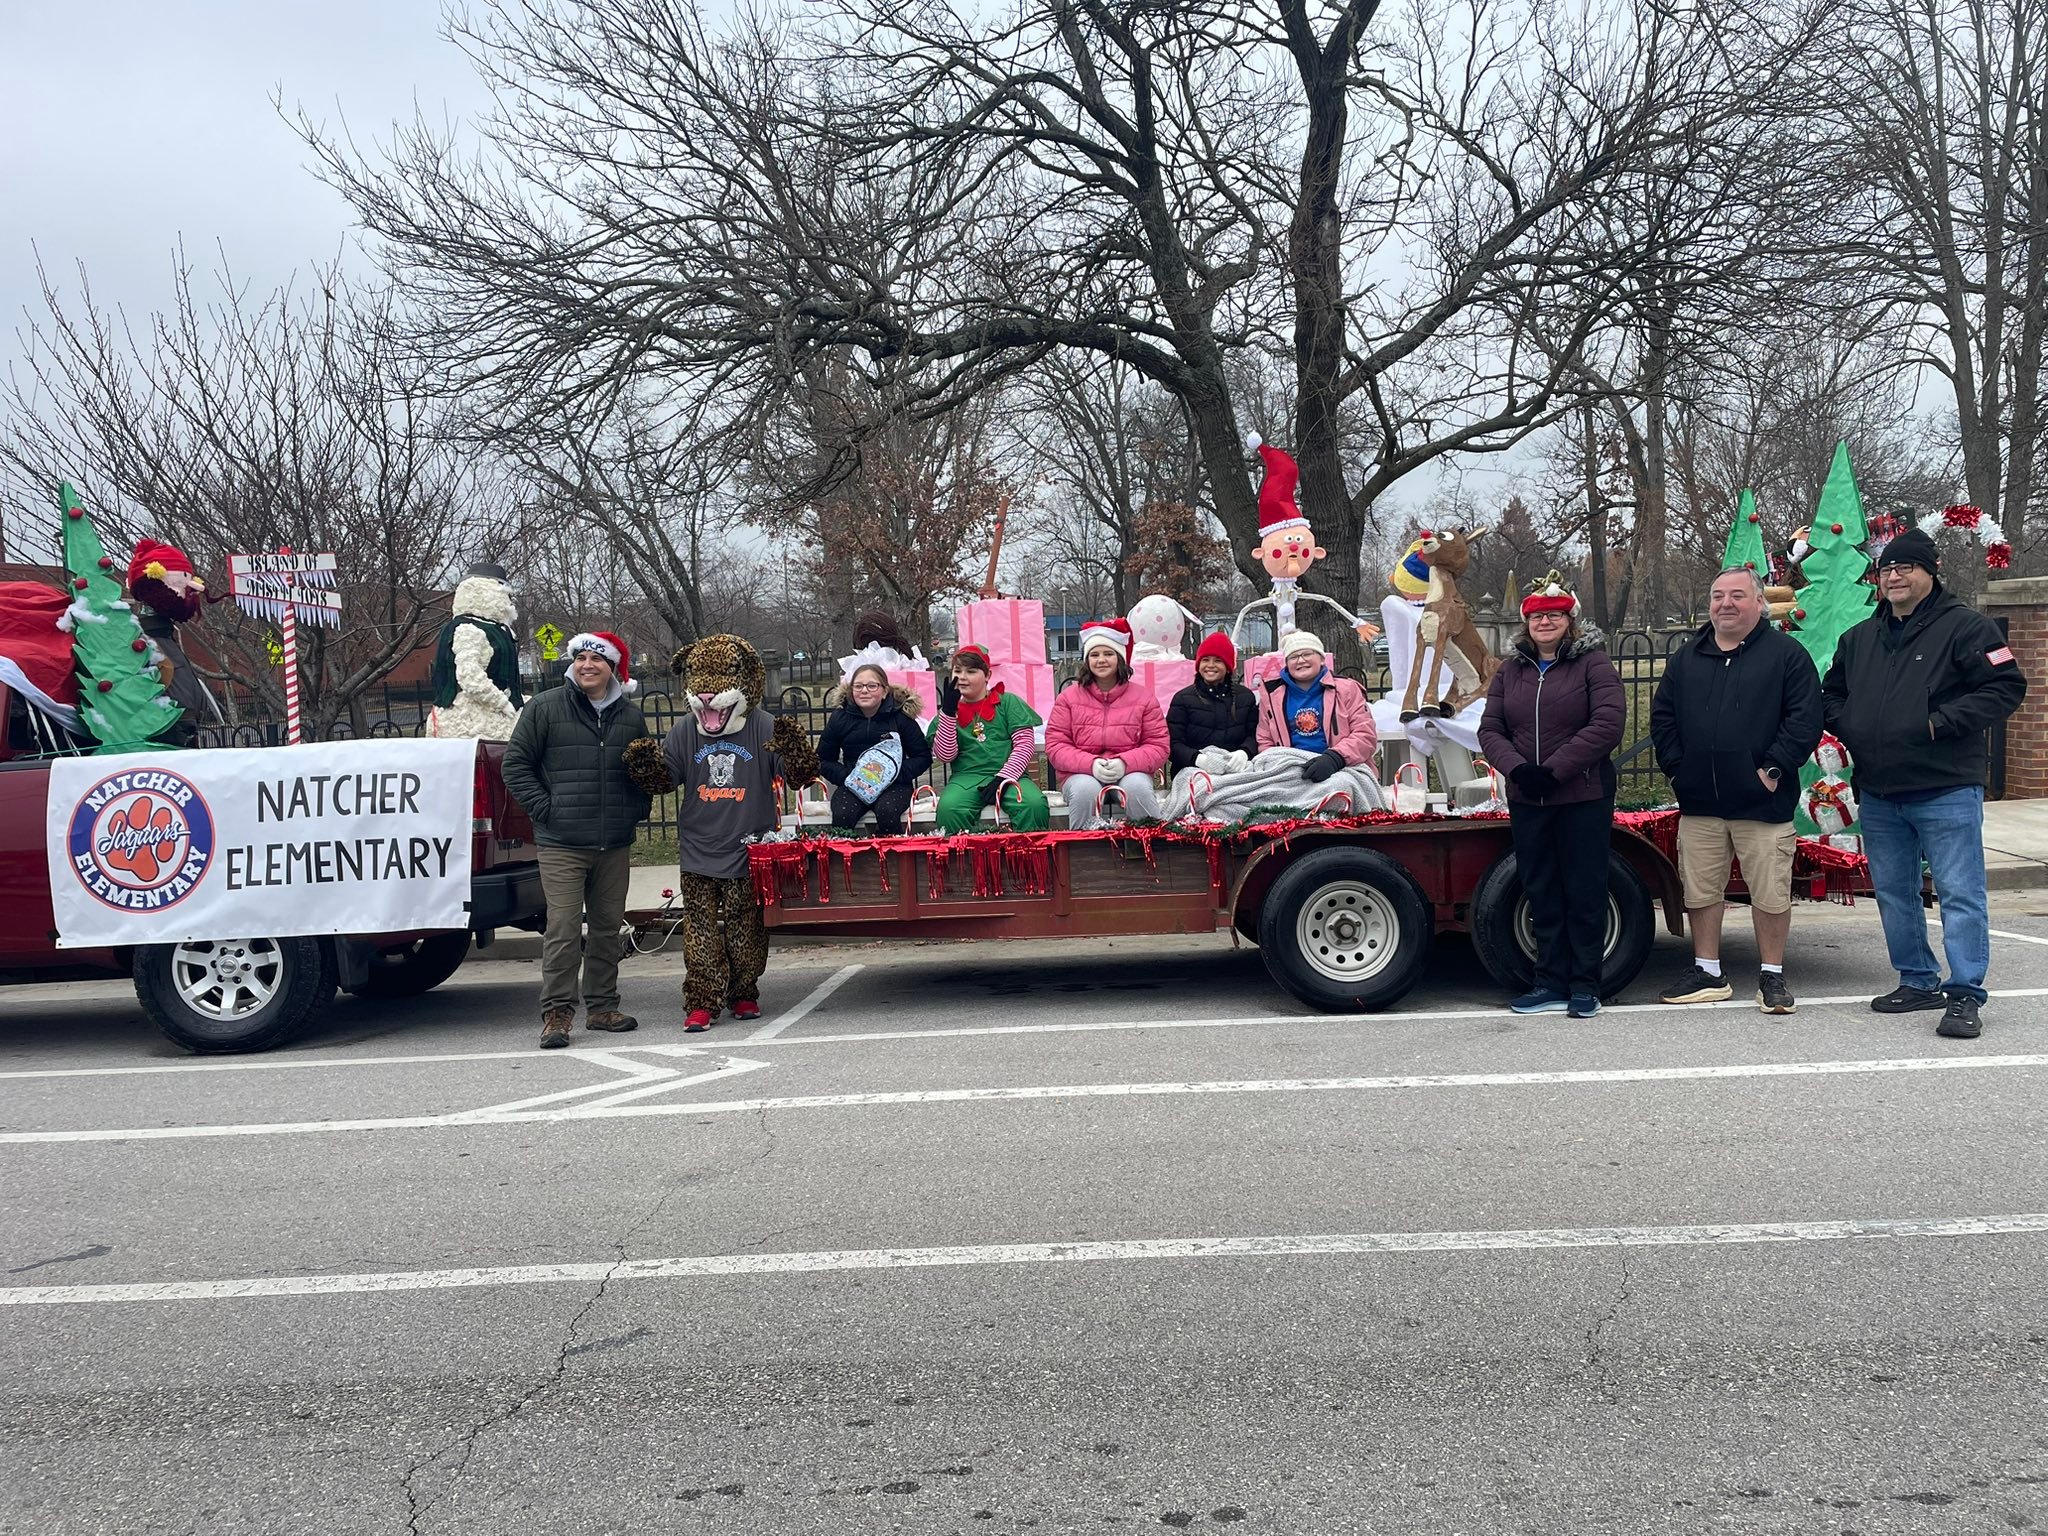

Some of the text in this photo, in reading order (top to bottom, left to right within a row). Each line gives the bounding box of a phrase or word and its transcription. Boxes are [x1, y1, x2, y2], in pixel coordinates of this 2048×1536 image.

[247, 553, 319, 573] ISLAND OF
[297, 586, 328, 608] TOYS
[581, 640, 606, 653] WCPS
[85, 772, 194, 812] NATCHER
[257, 773, 421, 822] NATCHER
[697, 784, 746, 803] Legacy
[97, 821, 192, 860] Jaguars
[75, 846, 208, 909] ELEMENTARY
[227, 837, 453, 890] ELEMENTARY
